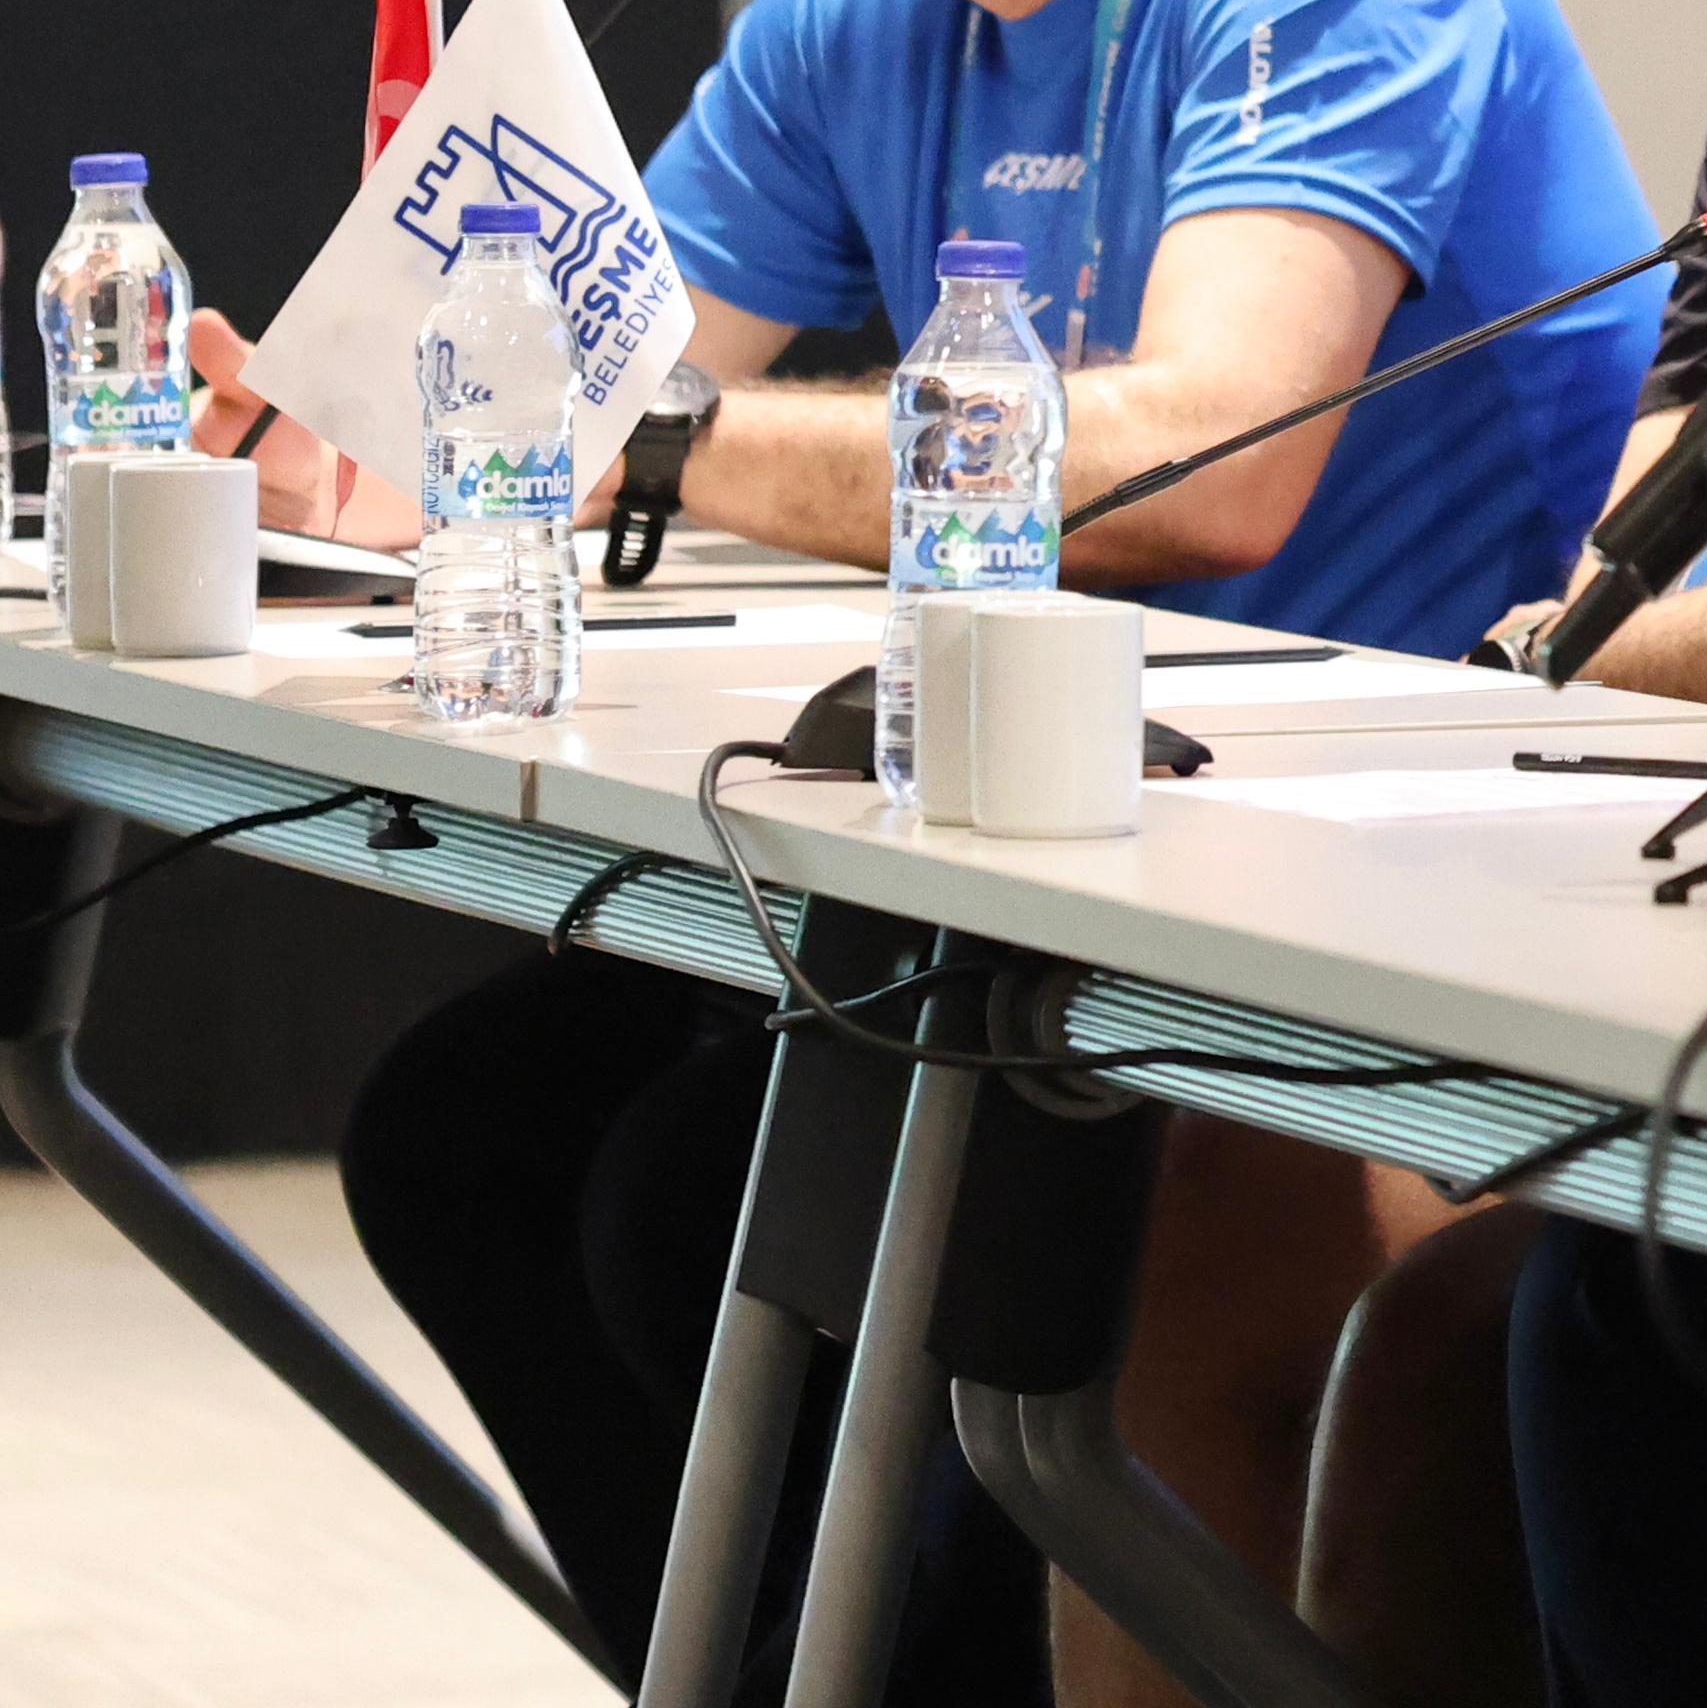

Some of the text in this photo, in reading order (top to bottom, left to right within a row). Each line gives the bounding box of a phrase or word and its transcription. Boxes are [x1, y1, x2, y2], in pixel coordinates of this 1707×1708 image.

[571, 216, 659, 382] EŞME
[88, 396, 181, 428] damla
[476, 468, 571, 499] damla
[932, 535, 1045, 568] damla
